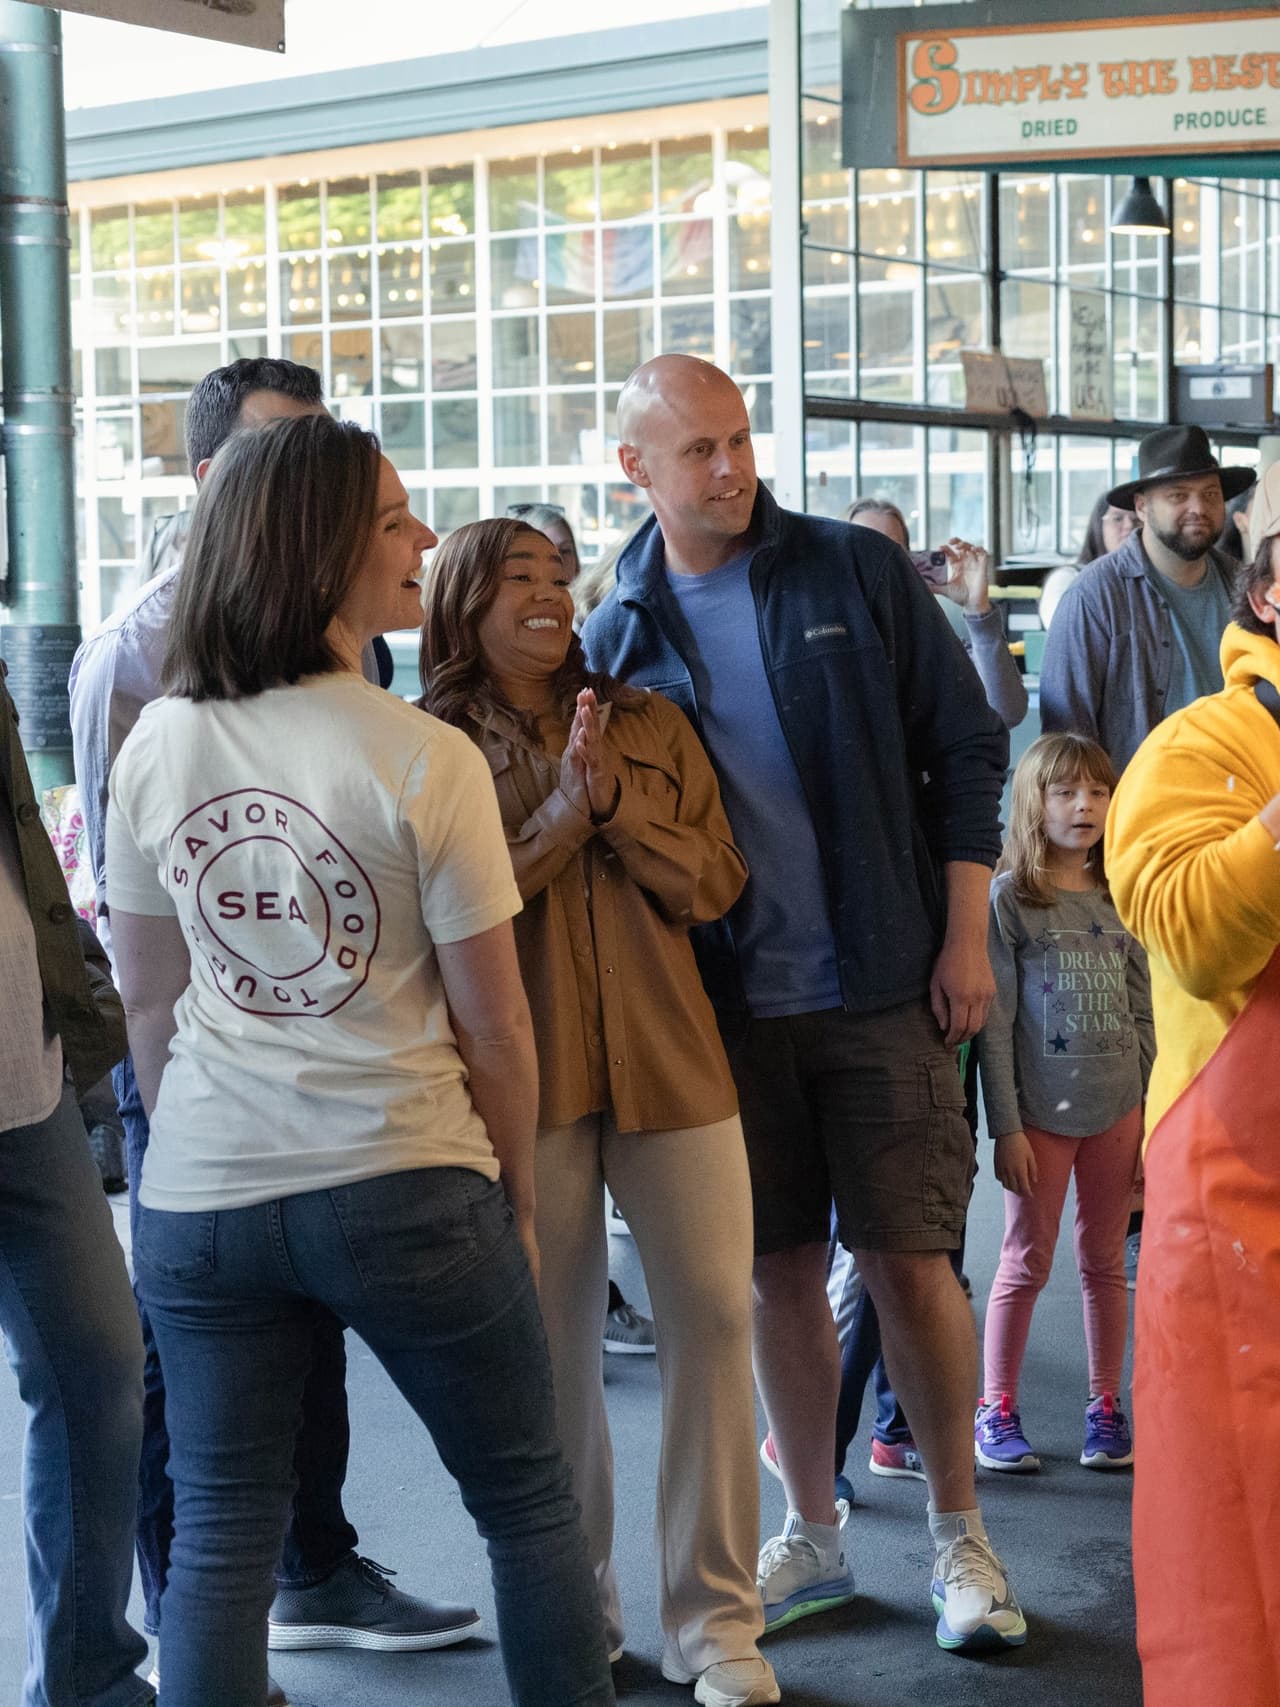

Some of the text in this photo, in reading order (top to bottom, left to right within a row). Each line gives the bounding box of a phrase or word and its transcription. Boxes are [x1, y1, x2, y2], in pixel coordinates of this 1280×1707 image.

[910, 38, 1089, 116] SIMPLY
[1098, 58, 1179, 99] THE
[1021, 108, 1267, 139] DRIED PRODUCE
[173, 803, 288, 888] SAVOR
[316, 849, 365, 970] FOOD
[217, 891, 308, 924] SEA
[1072, 992, 1114, 1012] THE
[1065, 1013, 1121, 1032] STARS
